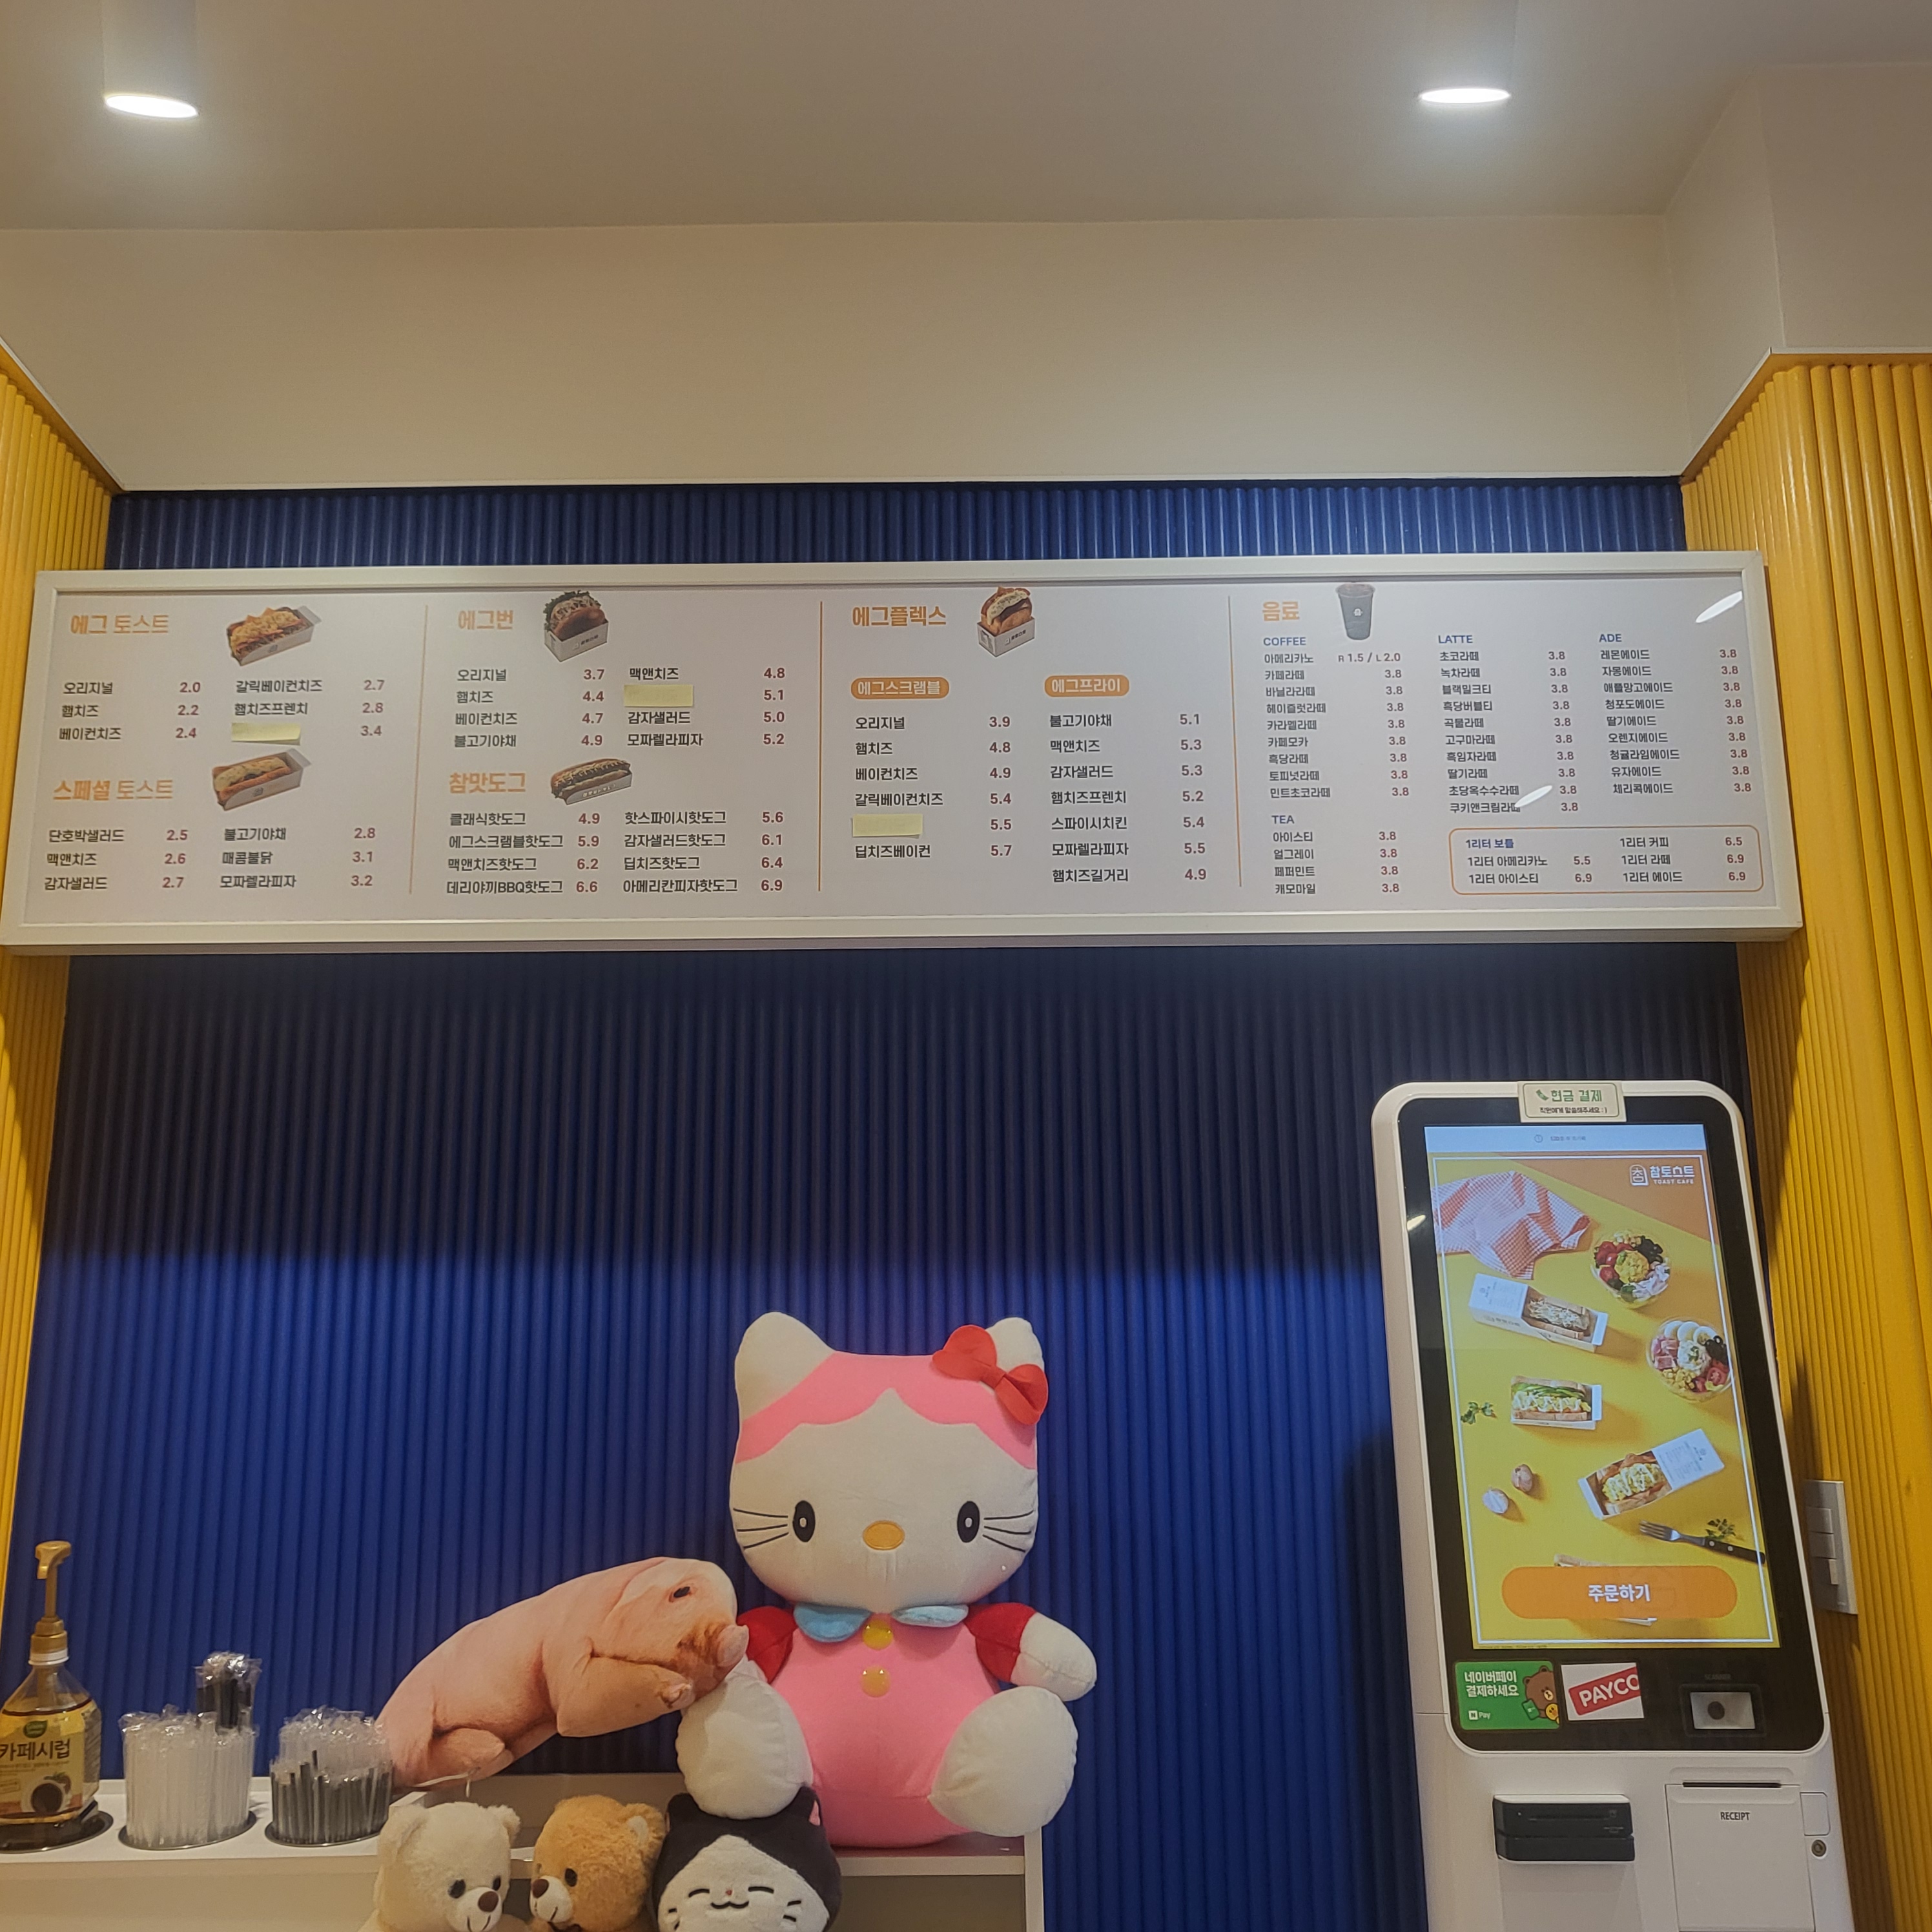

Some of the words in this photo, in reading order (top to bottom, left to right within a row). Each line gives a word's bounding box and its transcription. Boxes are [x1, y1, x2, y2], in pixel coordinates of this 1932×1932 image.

[852, 606, 946, 626] 에그플렉스
[1262, 602, 1299, 621] 음료
[71, 615, 107, 634] 에그
[113, 615, 168, 633] 토스트
[458, 610, 513, 630] 에그번
[1264, 637, 1306, 646] COFFEE
[1439, 635, 1473, 643] LATTE
[1264, 653, 1313, 664] 아메리카노
[1348, 653, 1363, 662] 1.5
[1384, 653, 1401, 661] 2.0
[1440, 652, 1479, 661] 초코라떼
[1601, 650, 1650, 659] 레몬에이드
[457, 669, 506, 681] 오리지널
[584, 669, 604, 679] 3.7
[630, 668, 679, 680] 맥앤치즈
[764, 668, 785, 678] 4.8
[1265, 670, 1304, 680] 카페라떼
[1441, 668, 1480, 678] 녹차라떼
[1602, 666, 1652, 676] 자몽에이드
[63, 683, 112, 694] 오리지널
[180, 682, 200, 692] 2.0
[236, 680, 322, 693] 갈릭베이컨치즈
[364, 679, 385, 690] 2.7
[858, 681, 941, 695] 에그스크램블
[1051, 679, 1120, 693] 에그프라이
[1266, 687, 1315, 697] 바닐라라떼
[457, 691, 493, 703] 햄치즈
[583, 691, 604, 701] 4.4
[764, 690, 783, 700] 5.1
[235, 703, 307, 715] 햄치즈프렌치
[362, 703, 383, 713] 2.8
[1606, 699, 1665, 710] 청포도에이드
[62, 705, 98, 717] 햄치즈
[178, 705, 199, 715] 2.2
[455, 712, 517, 725] 베이컨치즈
[582, 713, 603, 723] 4.7
[628, 712, 690, 724] 감자샐러드
[764, 712, 785, 722] 5.0
[856, 717, 905, 729] 오리지널
[989, 716, 1010, 727] 3.9
[1050, 714, 1111, 727] 불고기야채
[1180, 714, 1199, 724] 5.1
[361, 726, 382, 736] 3.4
[1267, 720, 1317, 730] 카라멜라떼
[59, 727, 121, 740] 베이컨치즈
[176, 728, 196, 738] 2.4
[1608, 733, 1668, 743] 오렌지에이드
[455, 735, 516, 747] 불고기야채
[581, 735, 602, 745] 4.9
[628, 734, 703, 746] 모짜렐라피자
[763, 734, 784, 745] 5.2
[1051, 740, 1100, 753] 맥앤치즈
[1181, 739, 1201, 750] 5.3
[1268, 737, 1308, 747] 카페모카
[1446, 735, 1495, 745] 고구마라떼
[856, 743, 892, 755] 햄치즈
[990, 742, 1011, 752] 4.8
[1269, 754, 1308, 764] 흑당라떼
[856, 768, 918, 781] 베이컨치즈
[990, 768, 1011, 778] 4.9
[1051, 766, 1113, 778] 감자샐러드
[1182, 765, 1202, 776] 5.3
[1612, 766, 1661, 777] 유자에이드
[449, 772, 526, 794] 참맛도그
[1613, 783, 1673, 794] 체리콕에이드
[53, 780, 110, 801] 스페셜
[116, 780, 172, 799] 토스트
[1270, 788, 1330, 798] 민트초코라떼
[1449, 786, 1519, 796] 초당옥수수라떼
[855, 793, 943, 807] 갈릭베이컨치즈
[991, 793, 1011, 804] 5.4
[1051, 791, 1125, 804] 햄치즈프렌치
[1183, 790, 1204, 801] 5.2
[450, 813, 526, 826] 클래식핫도그
[579, 813, 600, 824] 4.9
[625, 811, 726, 825] 핫스파이시핫도그
[763, 812, 783, 823] 5.6
[1052, 817, 1127, 830] 스파이시치킨
[1184, 817, 1204, 827] 5.4
[1271, 816, 1295, 824] TEA
[991, 819, 1011, 830] 5.5
[49, 830, 124, 842] 단호박샐러드
[167, 830, 188, 841] 2.5
[224, 828, 286, 841] 불고기야채
[355, 828, 375, 838] 2.8
[624, 834, 725, 847] 감자샐러드핫도그
[762, 834, 781, 845] 6.1
[1273, 832, 1313, 842] 아이스티
[449, 835, 563, 848] 에그스크램블핫도그
[578, 836, 599, 847] 5.9
[1466, 839, 1491, 848] 1리터
[1620, 838, 1645, 847] 1리터
[1649, 837, 1669, 847] 커피
[1725, 837, 1742, 846] 6.5
[856, 845, 930, 858] 딥치즈베이컨
[991, 845, 1011, 856] 5.7
[1053, 843, 1129, 856] 모짜렐라피자
[1184, 843, 1205, 854] 5.5
[1274, 849, 1313, 859] 얼그레이
[47, 853, 96, 866] 맥앤치즈
[165, 853, 186, 864] 2.6
[353, 852, 372, 862] 3.1
[1468, 856, 1494, 867] 1리터
[1497, 856, 1548, 866] 아메리카노
[1574, 856, 1590, 865] 5.5
[1621, 855, 1647, 865] 1리터
[1650, 854, 1670, 865] 라떼
[1727, 854, 1743, 863] 6.9
[448, 858, 537, 871] 맥앤치즈핫도그
[577, 858, 598, 869] 6.2
[624, 857, 699, 870] 딥치즈핫도그
[762, 857, 783, 868] 6.4
[1053, 869, 1128, 882] 햄치즈길거리
[1185, 869, 1206, 879] 4.9
[1275, 867, 1315, 876] 페퍼민트
[1381, 866, 1398, 875] 3.8
[1623, 872, 1649, 882] 1리터
[1652, 872, 1683, 882] 에이드
[1729, 872, 1745, 881] 6.9
[45, 877, 107, 890] 감자샐러드
[163, 877, 184, 888] 2.7
[220, 875, 296, 888] 모짜렐라피자
[351, 875, 373, 886] 3.2
[1469, 874, 1495, 884] 1리터
[1499, 874, 1538, 883] 아이스티
[1575, 874, 1592, 882] 6.9
[447, 881, 562, 894] 데리야끼BBQ핫도그
[577, 881, 597, 892] 6.6
[623, 879, 737, 892] 아메리칸피자핫도그
[761, 879, 782, 891] 6.9
[1275, 884, 1315, 894] 캐모마일
[1551, 1090, 1574, 1102] 현금
[1579, 1090, 1601, 1102] 결제
[1650, 1166, 1695, 1178] 참토스트
[1588, 1584, 1650, 1603] 주문하기
[1464, 1670, 1516, 1683] 네이버페이
[1466, 1685, 1519, 1697] 결제하세요
[1579, 1674, 1639, 1707] PAYCO
[0, 1739, 70, 1761] 카페시럽
[1720, 1812, 1750, 1821] RECEIPT
